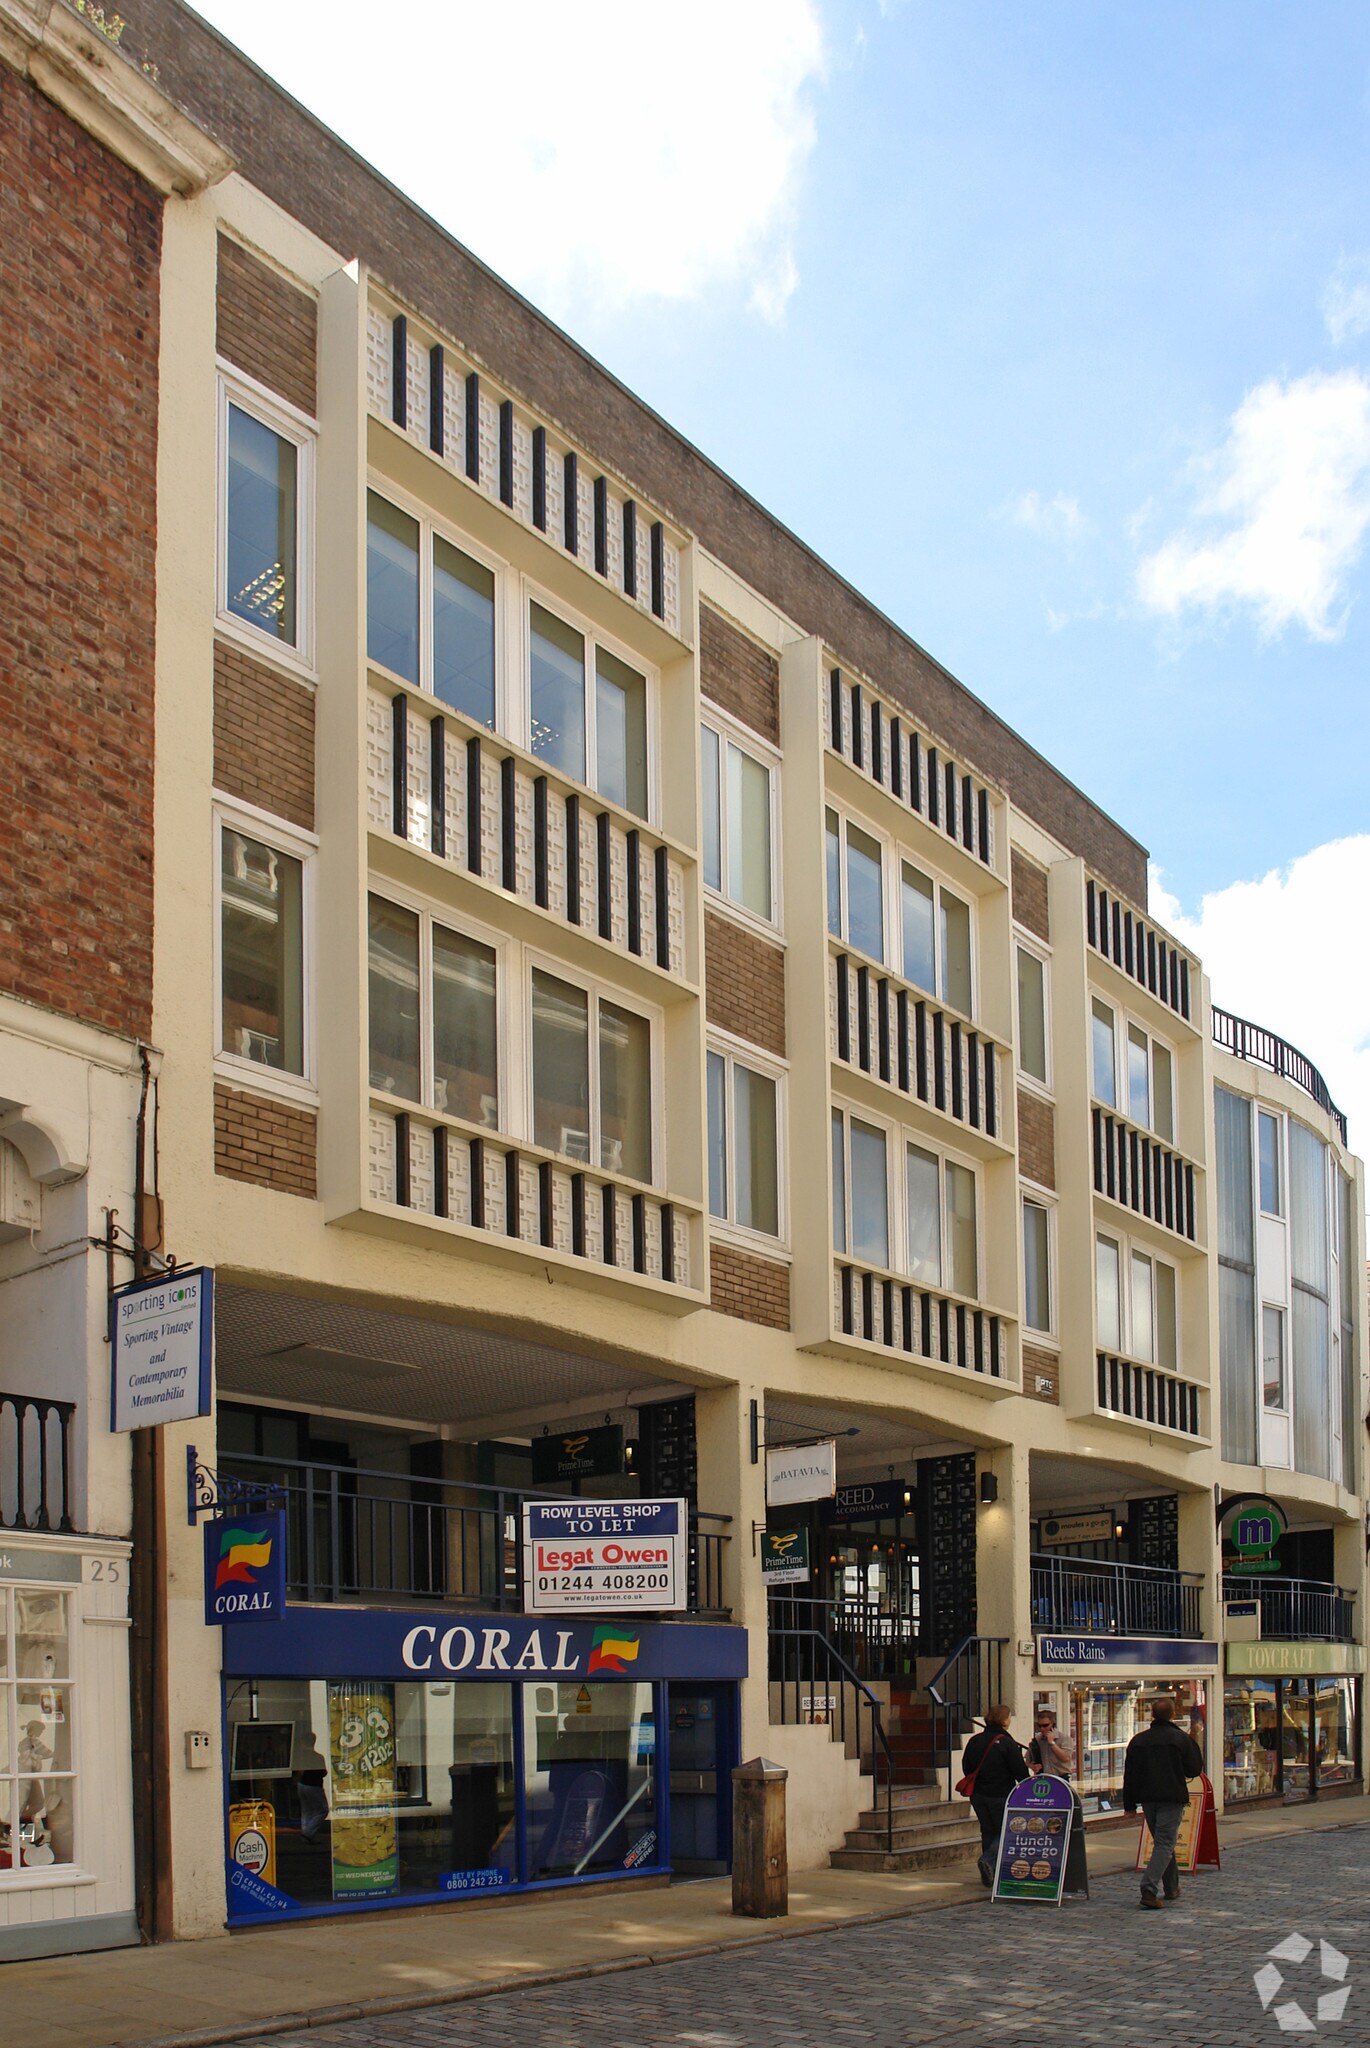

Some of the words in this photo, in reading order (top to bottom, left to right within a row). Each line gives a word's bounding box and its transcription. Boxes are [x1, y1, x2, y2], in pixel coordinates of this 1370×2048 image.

[122, 1294, 164, 1318] sporting
[169, 1285, 196, 1303] icons
[124, 1329, 158, 1348] Sporting
[161, 1320, 193, 1336] Vintage
[150, 1349, 166, 1364] and
[129, 1366, 187, 1387] Contemporary
[131, 1387, 185, 1408] Memorabilia
[780, 1466, 821, 1479] BATAVIA
[836, 1487, 875, 1506] REED
[541, 1508, 573, 1519] ROW
[578, 1506, 618, 1518] LEVEL
[623, 1505, 661, 1517] SHOP
[835, 1502, 890, 1515] ACCOUNTANCY
[566, 1520, 593, 1533] TO
[601, 1518, 636, 1532] LET
[1238, 1517, 1273, 1546] m
[538, 1546, 594, 1572] Legat
[602, 1544, 668, 1563] Owen
[765, 1555, 803, 1567] PrimeTime
[91, 1560, 119, 1583] 25
[539, 1576, 594, 1591] 01244
[602, 1574, 668, 1589] 408200
[215, 1591, 272, 1613] CORAL
[564, 1593, 643, 1602] www.legatowen.co.uk
[402, 1625, 580, 1670] CORAL
[1046, 1640, 1075, 1659] Reeds
[1078, 1641, 1105, 1660] Rains
[1246, 1647, 1314, 1669] TOYCRAFT
[804, 1699, 820, 1707] REFGE
[340, 1721, 364, 1748] 3
[367, 1711, 390, 1739] 3
[238, 1841, 263, 1854] Cash
[1015, 1835, 1052, 1846] lunch
[239, 1854, 263, 1862] Machine
[634, 1844, 655, 1868] HERE!
[1008, 1847, 1015, 1855] a
[1020, 1847, 1058, 1858] go-go
[447, 1879, 467, 1890] 0800
[470, 1877, 486, 1887] 242
[488, 1875, 503, 1885] 232
[452, 1872, 464, 1880] BET
[476, 1869, 498, 1877] PHONE
[243, 1877, 288, 1910] coral.co.uk
